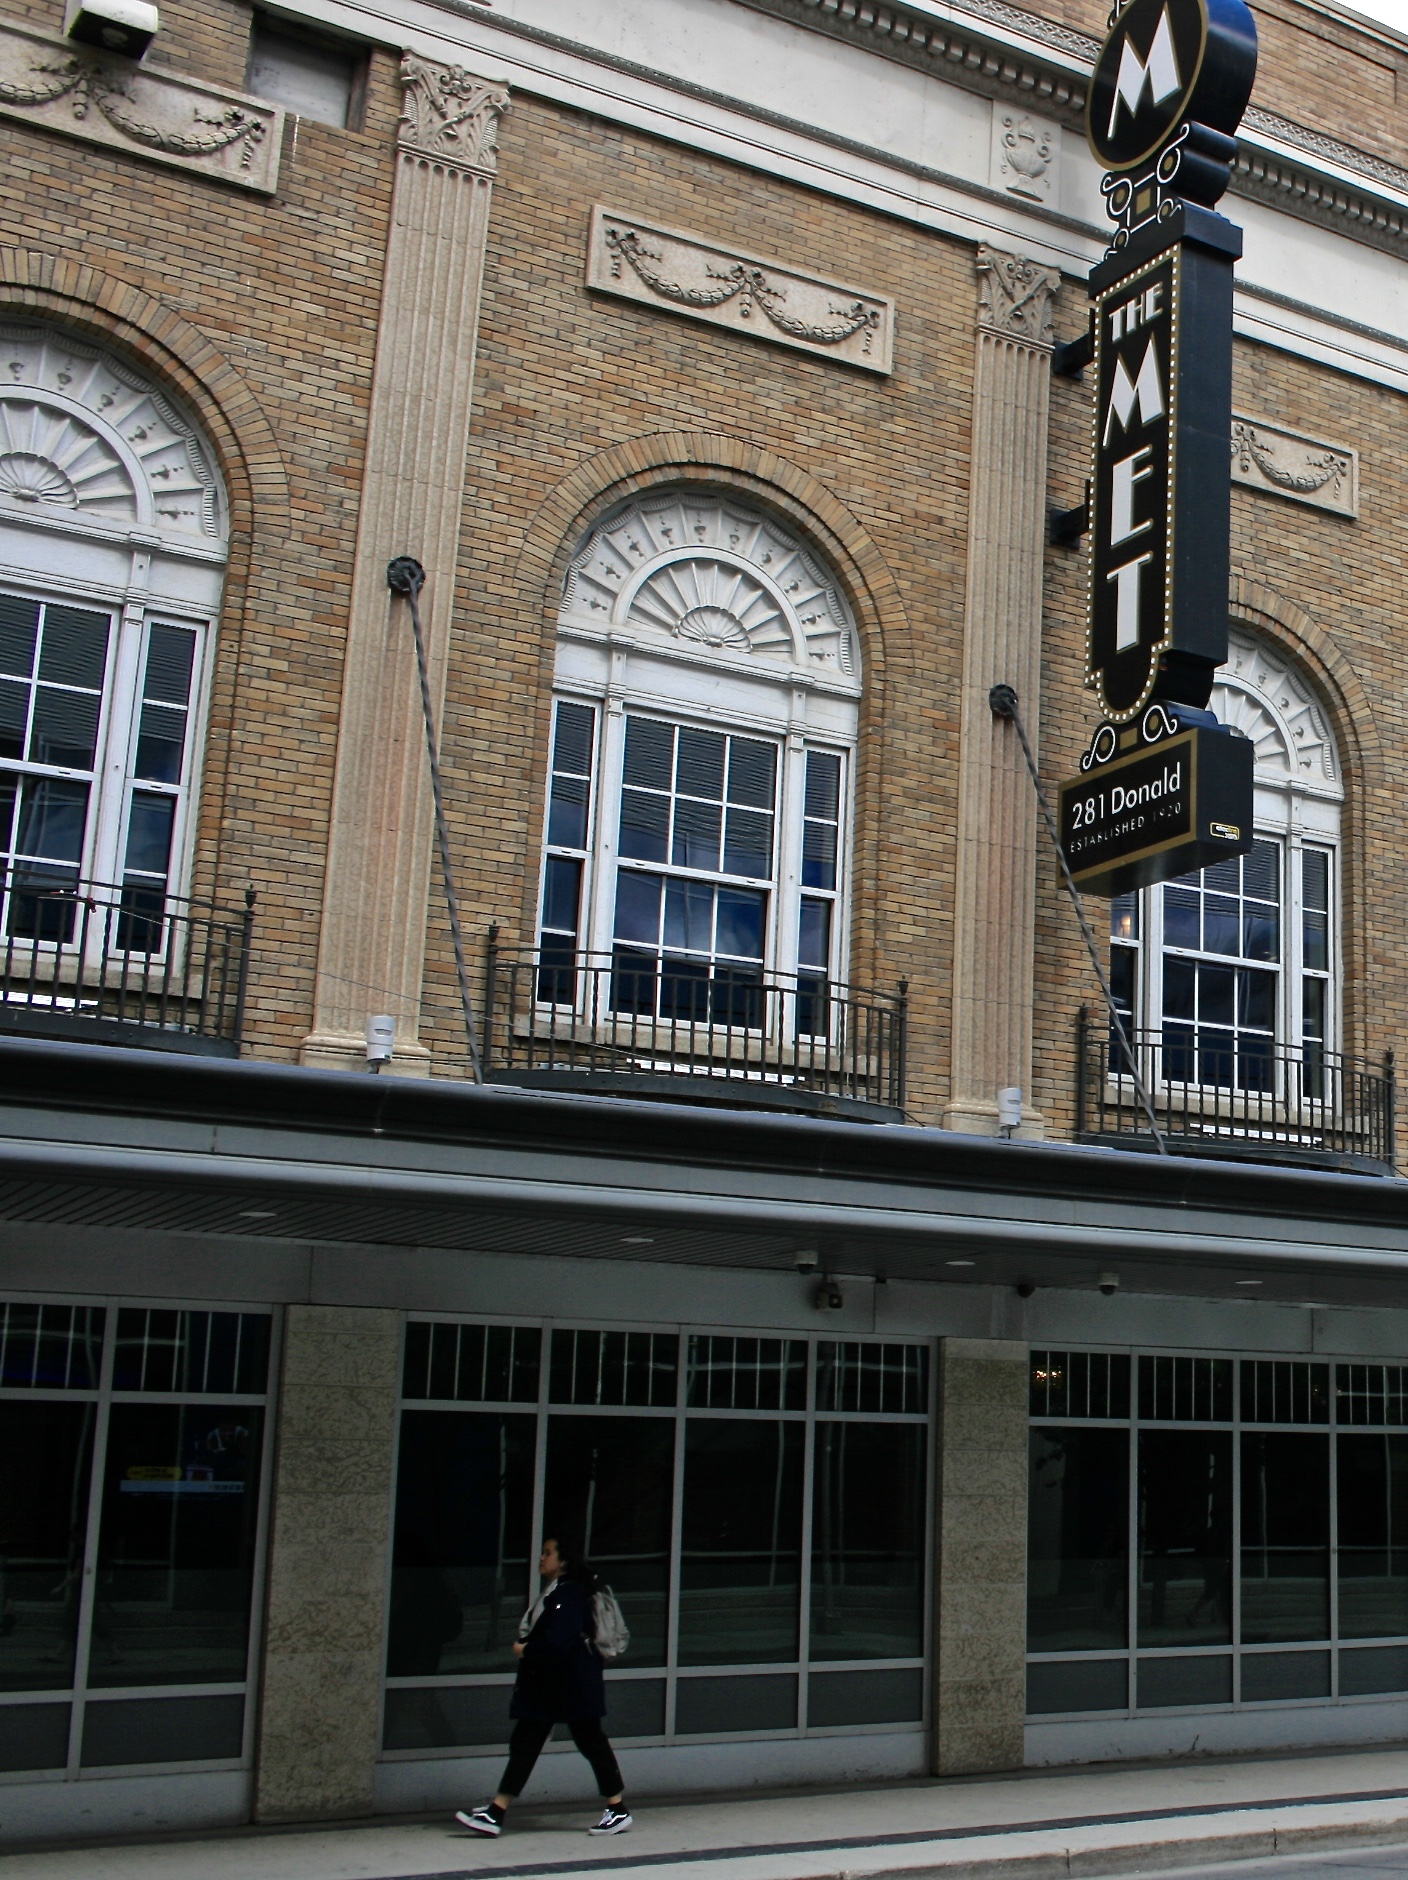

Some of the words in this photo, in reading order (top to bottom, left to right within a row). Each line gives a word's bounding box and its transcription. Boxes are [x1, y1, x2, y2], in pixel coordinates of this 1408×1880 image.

[1107, 8, 1182, 141] M
[1109, 282, 1163, 343] THE
[1102, 332, 1165, 653] MET
[1072, 793, 1105, 830] 281
[1111, 761, 1181, 815] Donald
[1070, 815, 1145, 853] ESTABLISHED
